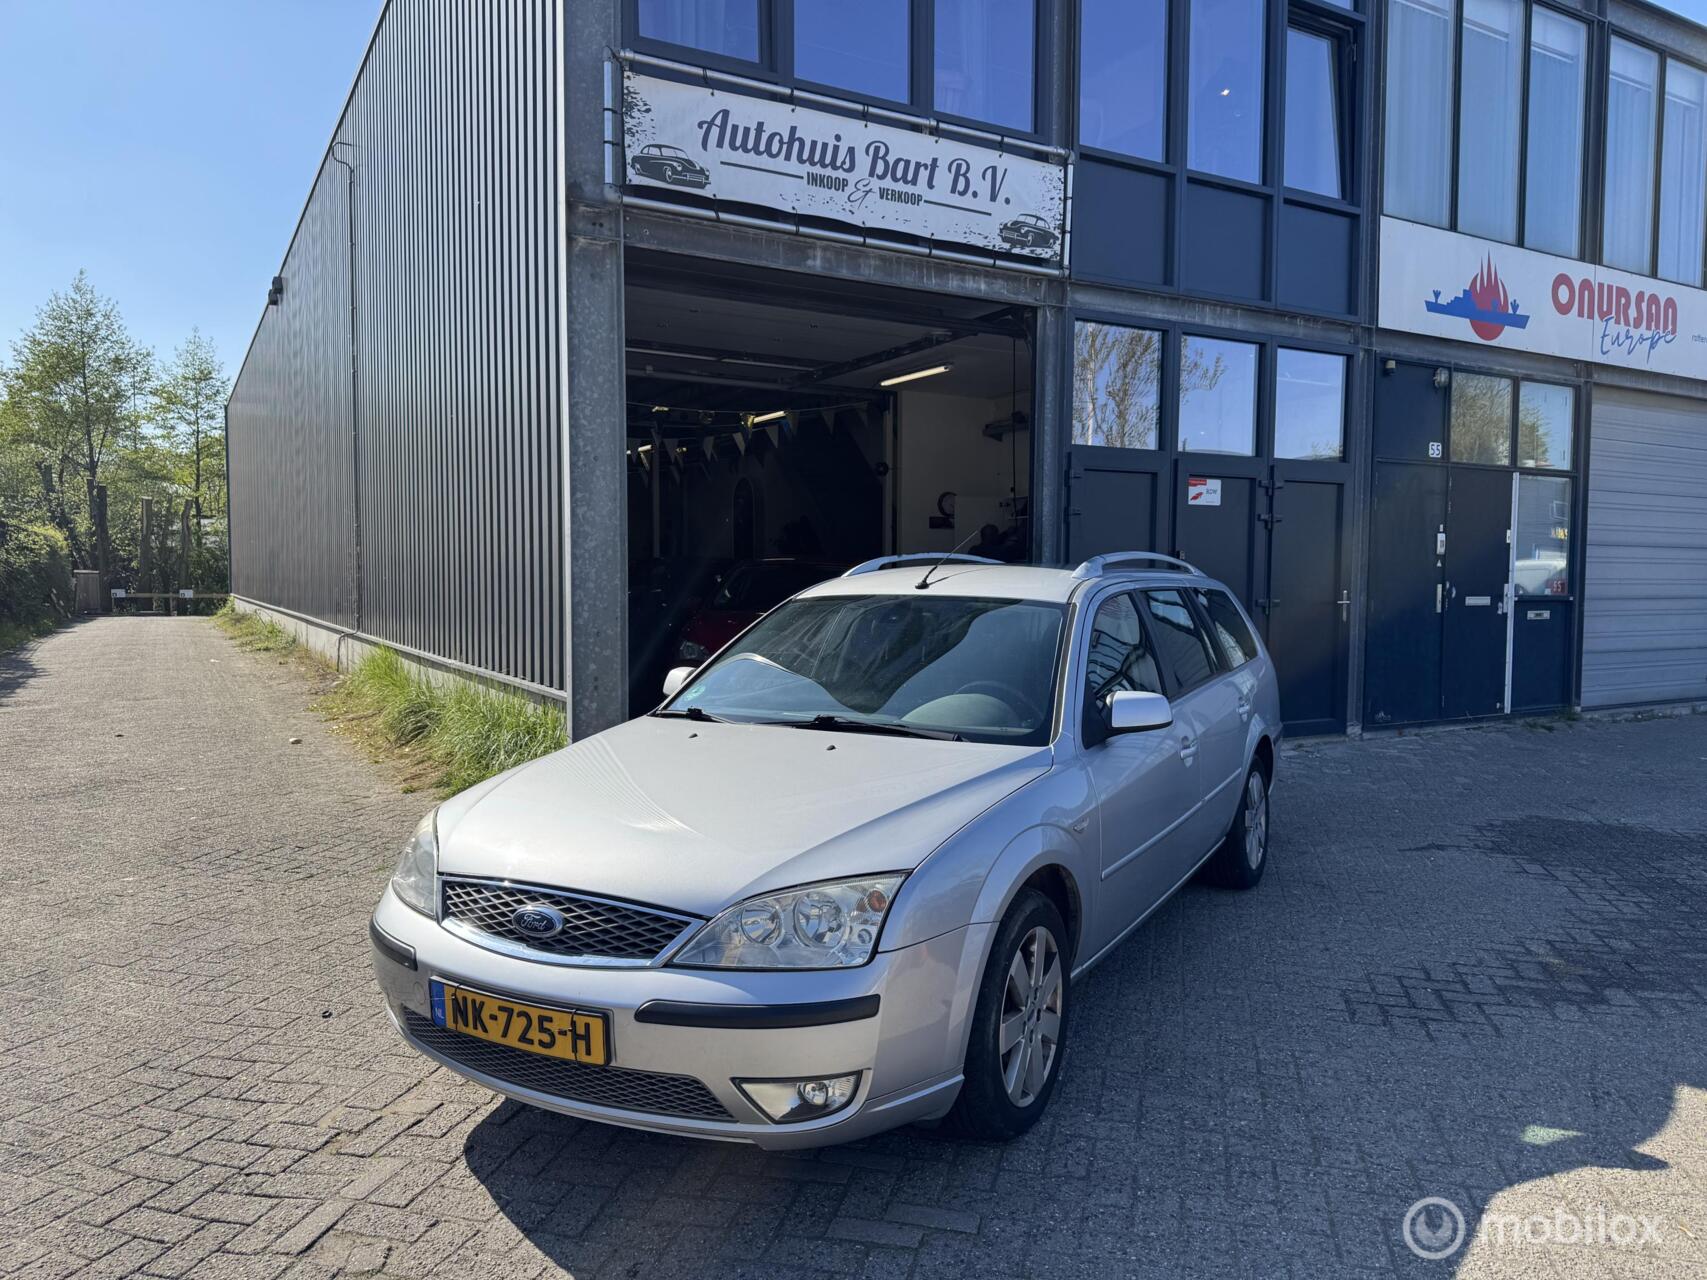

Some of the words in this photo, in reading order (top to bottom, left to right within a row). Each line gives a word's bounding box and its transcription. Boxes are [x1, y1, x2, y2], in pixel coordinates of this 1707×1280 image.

[697, 108, 857, 174] Autohuis
[865, 140, 939, 190] Bart
[948, 158, 1012, 205] B.V.
[806, 171, 849, 193] INKOOP
[878, 186, 923, 207] VERKOOP
[1552, 273, 1677, 335] ONURSAN
[1599, 316, 1678, 364] Europe
[1430, 443, 1441, 456] 55
[521, 913, 546, 930] Ford
[434, 1007, 445, 1019] NL
[451, 995, 592, 1056] NK-725-H
